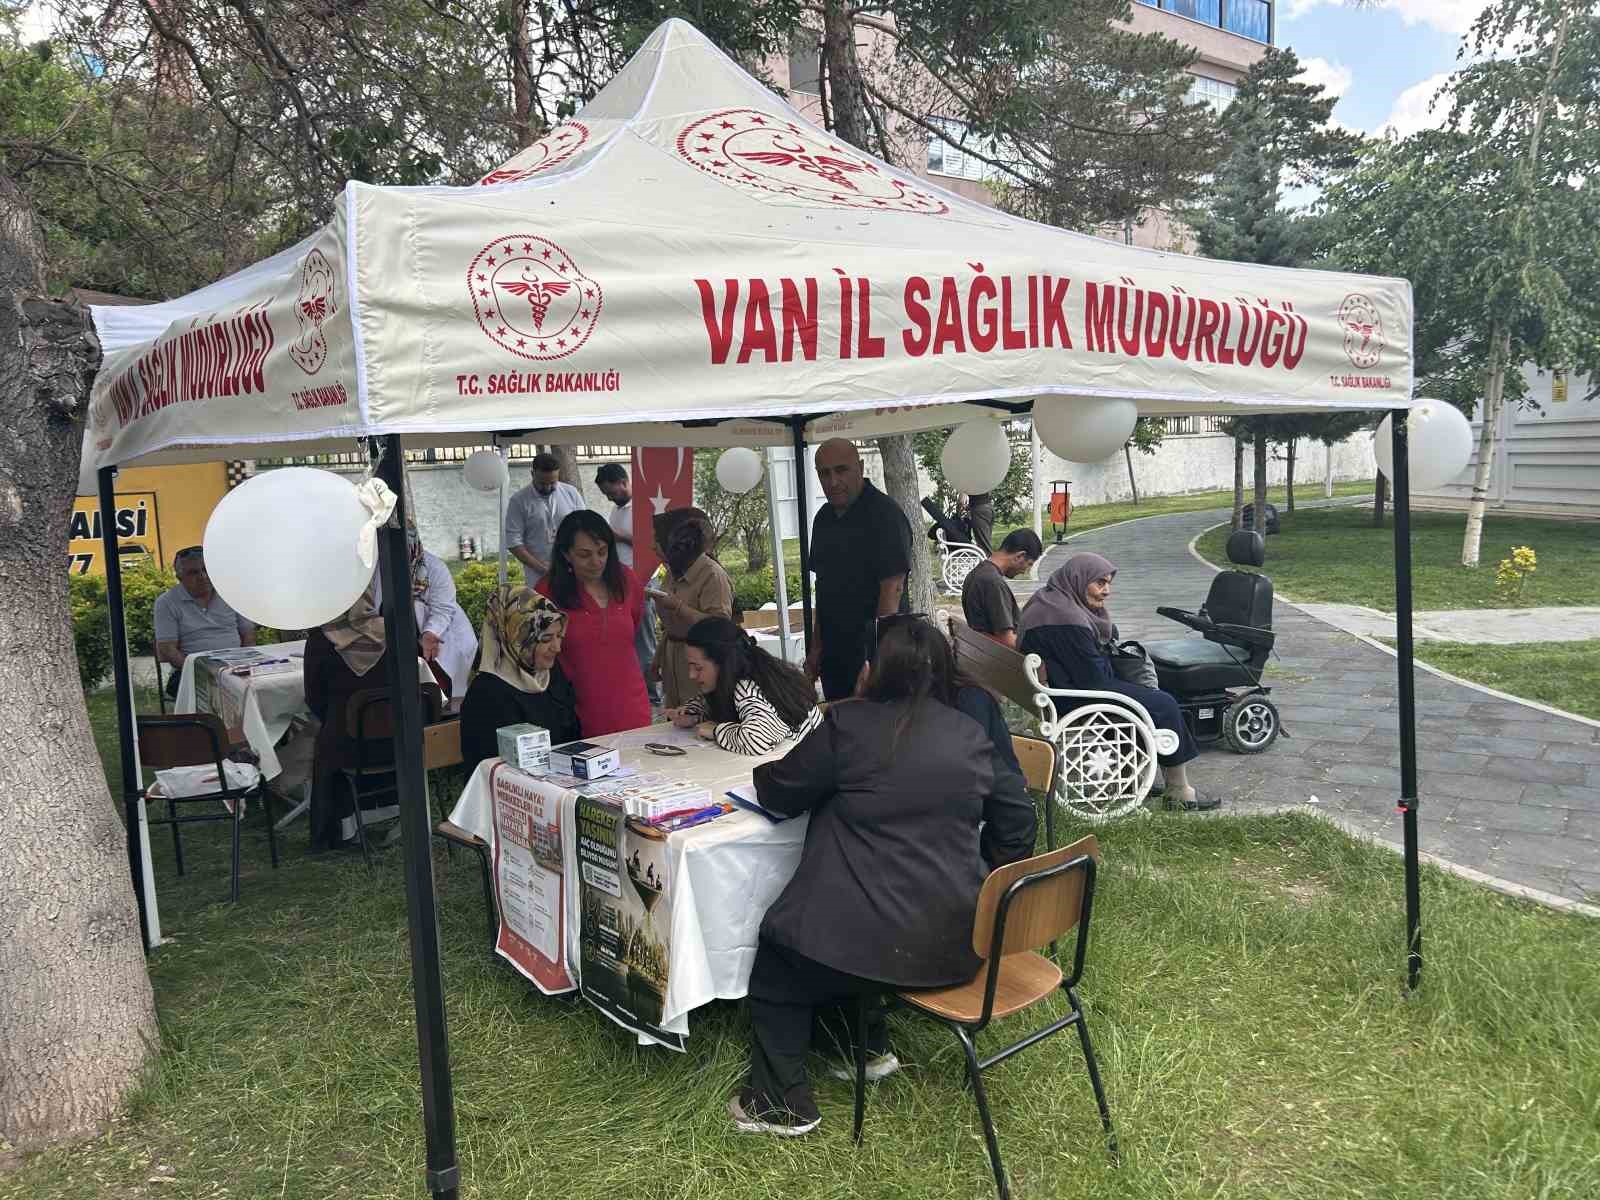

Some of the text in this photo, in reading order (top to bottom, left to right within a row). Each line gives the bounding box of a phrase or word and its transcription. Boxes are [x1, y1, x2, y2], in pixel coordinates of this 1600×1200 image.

[693, 262, 1309, 371] VAN İL SAĞLIK MÜDÜRLÜĞÜ
[457, 368, 621, 396] T.C. SAĞLIK BAKANLIĞI
